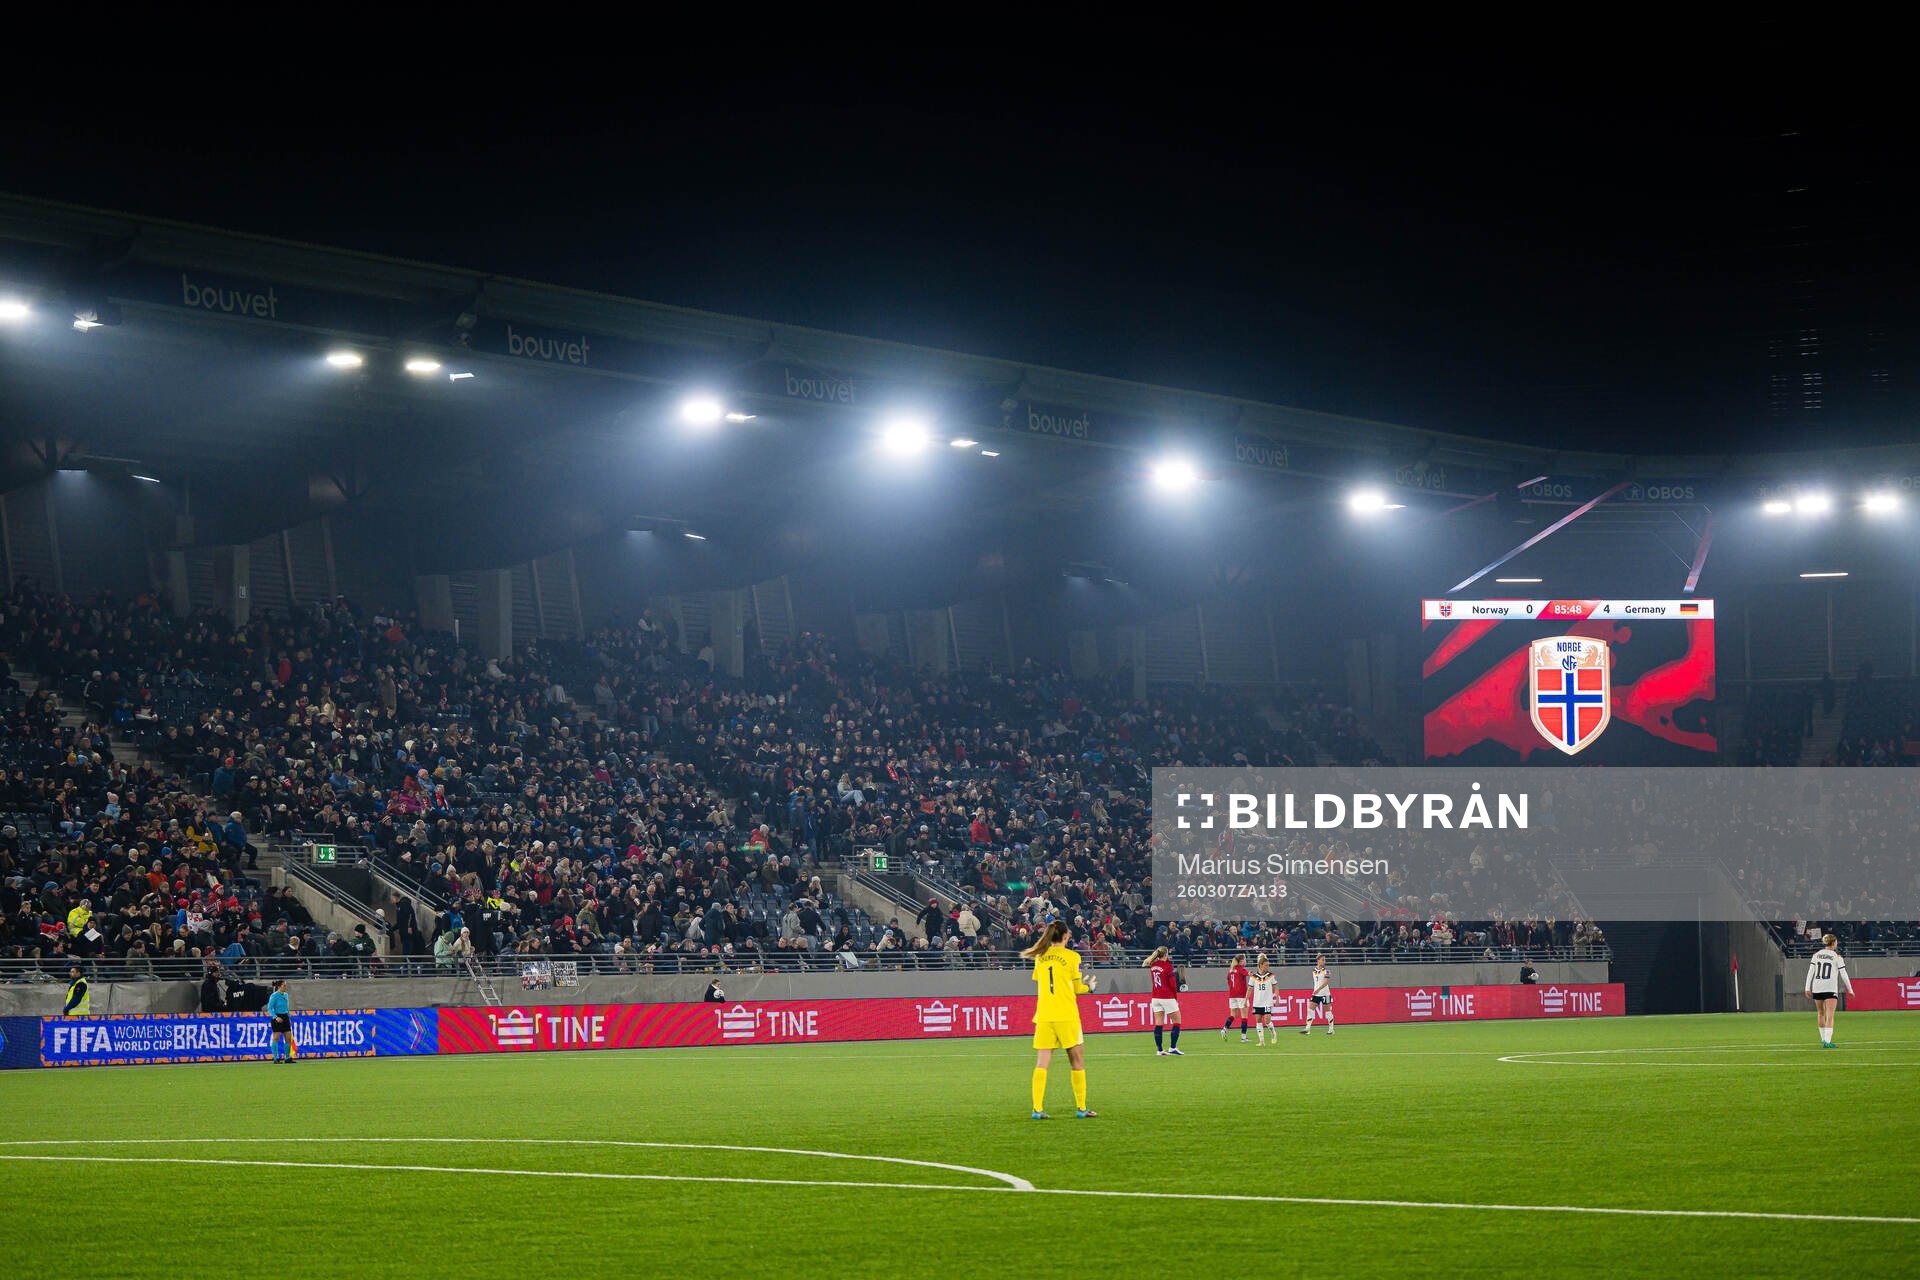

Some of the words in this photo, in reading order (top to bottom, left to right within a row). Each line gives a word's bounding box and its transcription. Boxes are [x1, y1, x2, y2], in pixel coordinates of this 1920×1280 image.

[182, 272, 278, 318] bouvet
[507, 324, 590, 365] bouvet
[785, 367, 857, 403] bouvet
[1027, 403, 1089, 438] bouvet
[1234, 437, 1288, 468] bouvet
[1533, 483, 1573, 498] OBOS
[1648, 486, 1696, 500] OBOS
[1472, 606, 1509, 615] Norway
[1526, 605, 1533, 614] 0
[1554, 605, 1582, 615] 85:48
[1603, 604, 1611, 614] 4
[1625, 605, 1666, 615] Germany
[1557, 641, 1582, 652] NORGE
[1048, 966, 1054, 994] 1
[1815, 961, 1832, 980] 10
[1440, 994, 1475, 1015] TINE
[1570, 991, 1602, 1012] TINE
[766, 1010, 818, 1037] TINE
[962, 1006, 1008, 1031] TINE
[54, 1026, 112, 1053] FIFA
[114, 1024, 172, 1039] WOMEN'S
[174, 1023, 235, 1050] BRASIL
[291, 1020, 364, 1047] UALIFIERS
[547, 1015, 605, 1044] TINE
[114, 1040, 150, 1051] WORLD
[152, 1039, 173, 1051] CUP
